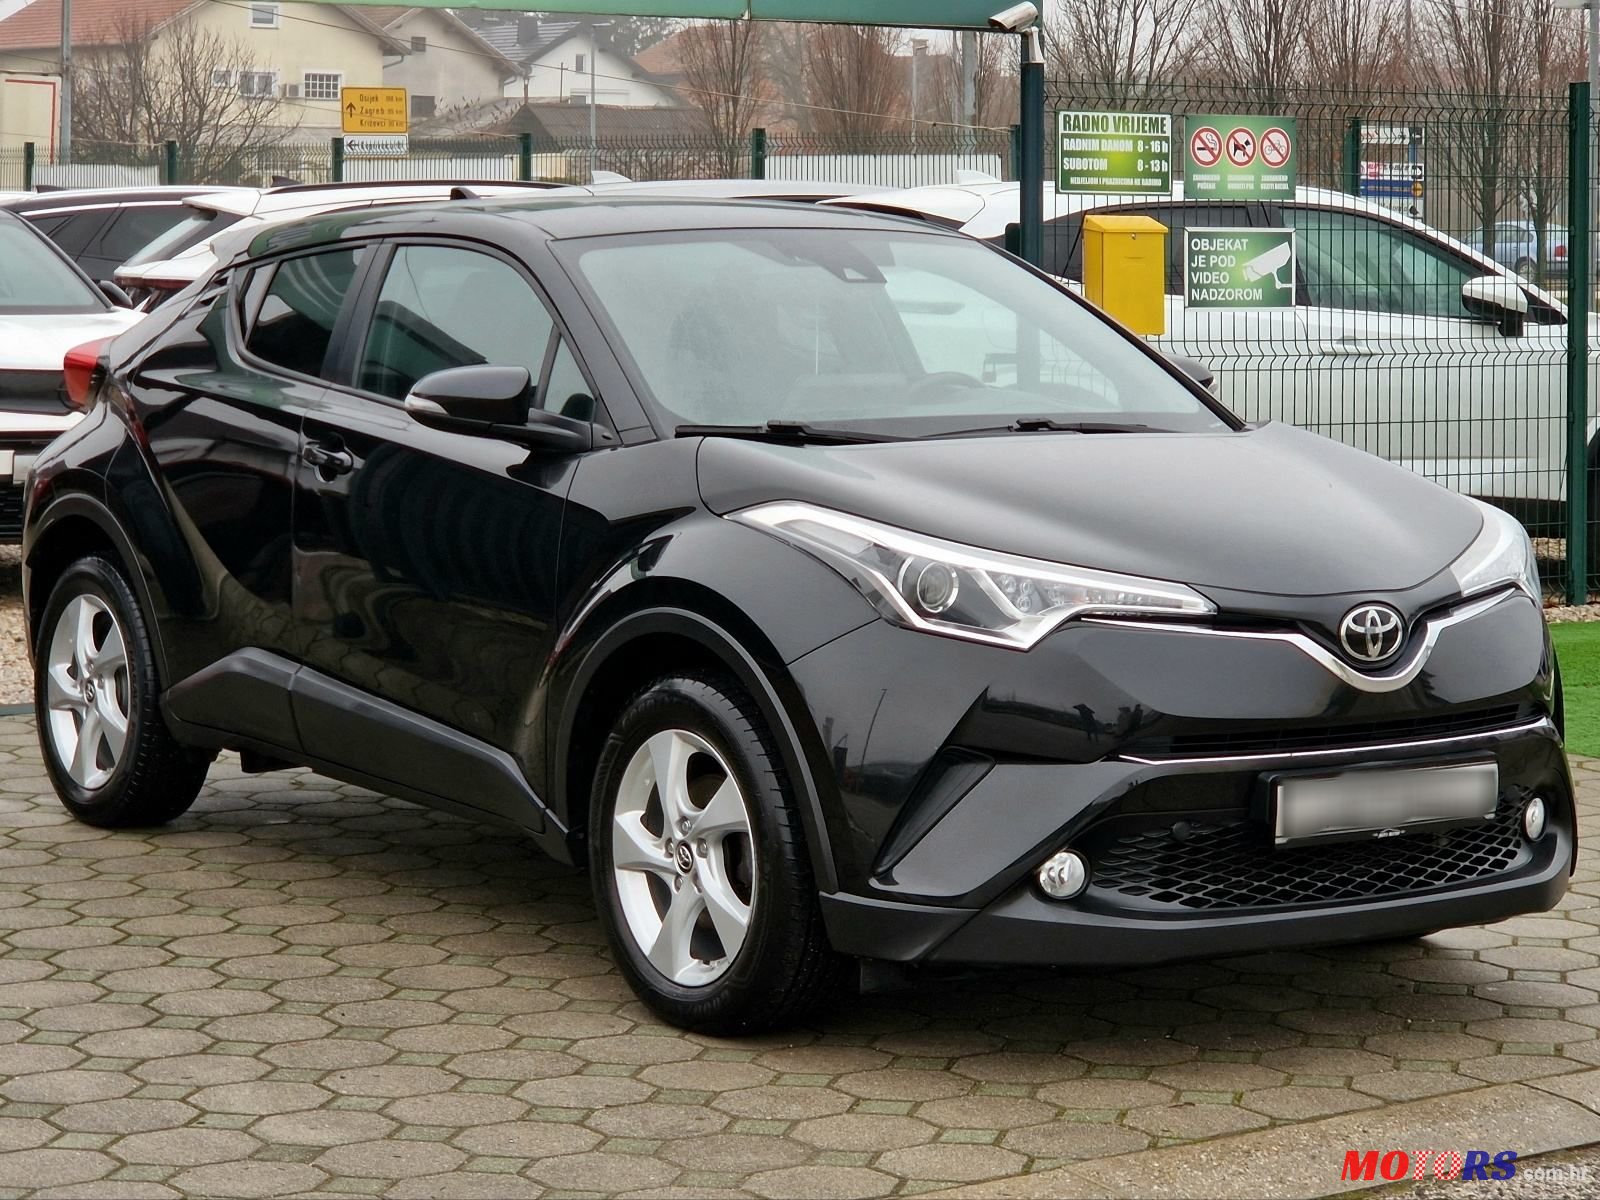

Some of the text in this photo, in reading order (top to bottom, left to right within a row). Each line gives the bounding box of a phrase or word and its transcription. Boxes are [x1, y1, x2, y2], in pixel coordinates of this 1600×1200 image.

[360, 94, 378, 104] Osijek
[360, 106, 384, 117] Zagreb
[1063, 114, 1167, 134] RADNO VRIJEME
[1063, 138, 1100, 151] RADNIM
[1101, 139, 1134, 152] DANOM
[1137, 140, 1144, 152] 8
[1150, 141, 1161, 153] 16
[1162, 141, 1169, 153] h
[1063, 158, 1108, 170] SUBOTOM
[1137, 159, 1144, 171] 8
[1150, 160, 1161, 172] 13
[1161, 160, 1168, 172] h
[1191, 238, 1248, 251] OBJEKAT
[1191, 255, 1236, 268] JE POD
[1191, 271, 1230, 284] VIDEO
[1191, 288, 1263, 301] NADZOROM
